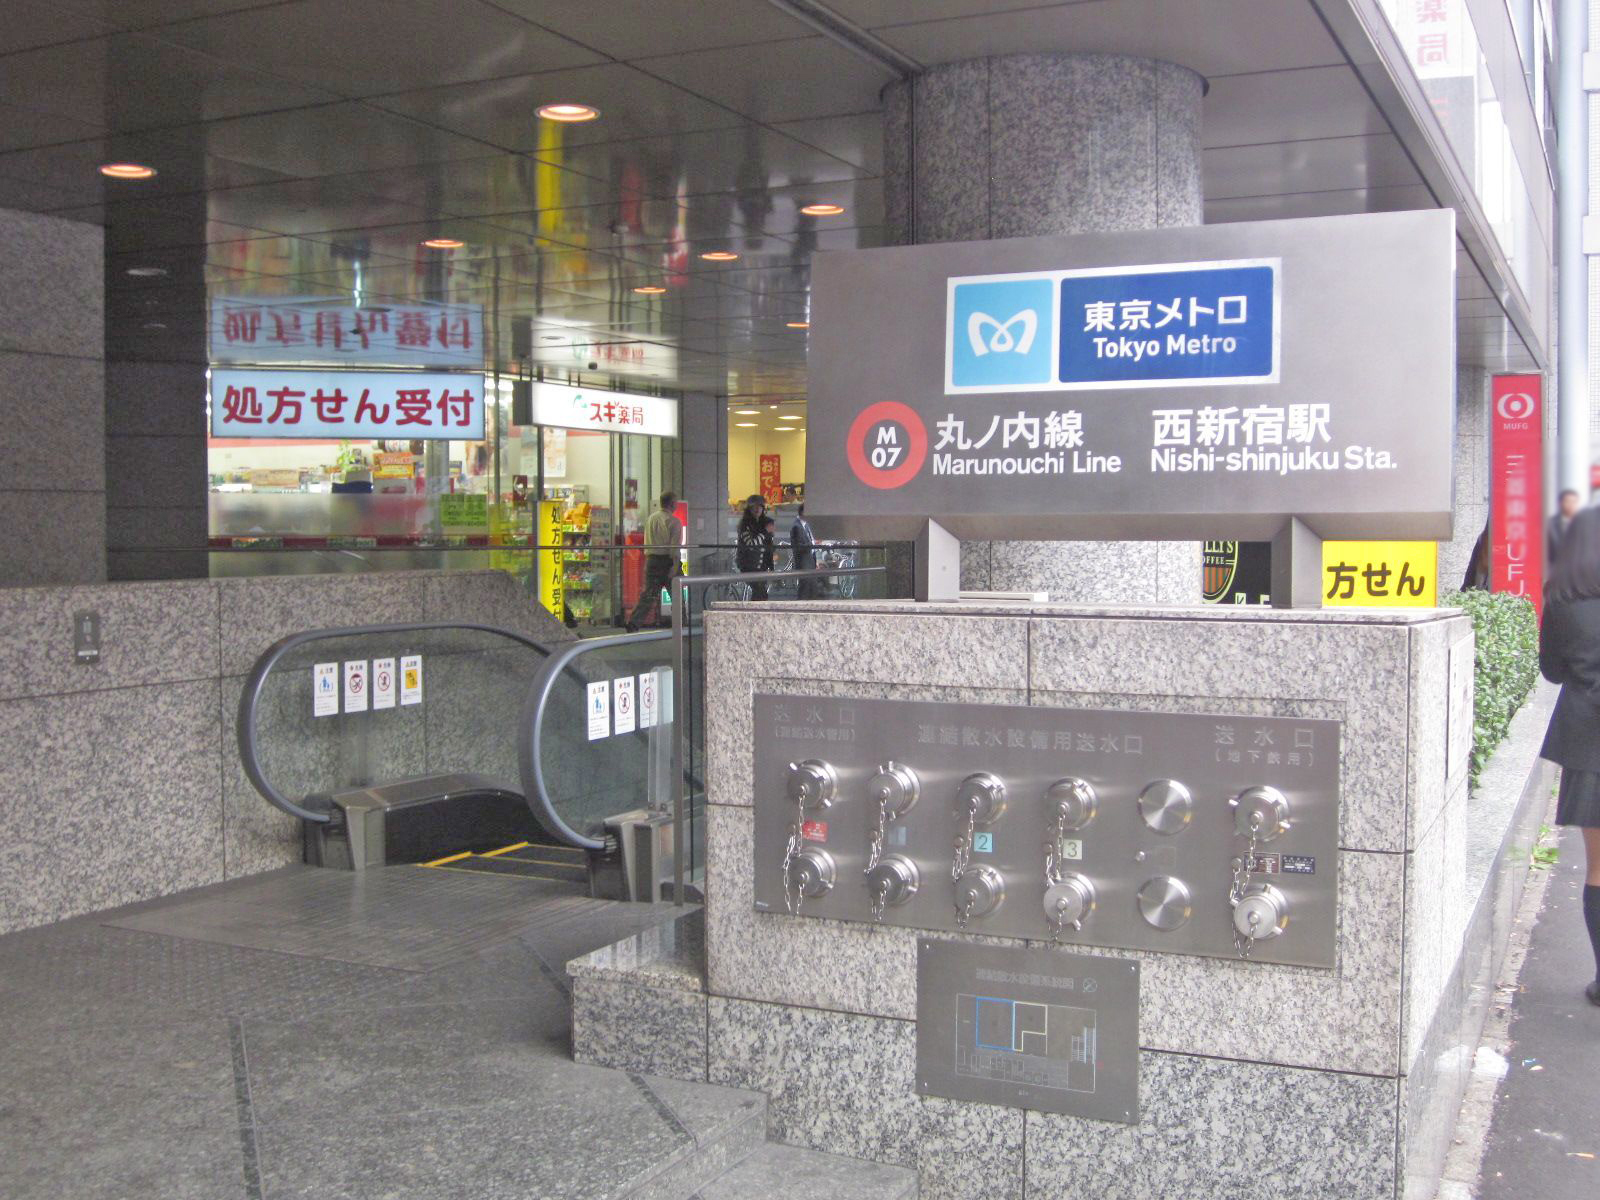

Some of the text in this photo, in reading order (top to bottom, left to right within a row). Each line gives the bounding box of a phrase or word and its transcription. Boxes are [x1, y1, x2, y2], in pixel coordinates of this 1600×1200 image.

[1083, 295, 1248, 332] 東京メトロ
[1092, 333, 1237, 363] Tokyo Metro
[222, 384, 475, 427] 処方せん受付
[589, 400, 644, 426] スギ薬局
[876, 426, 897, 445] M
[933, 403, 1332, 452] 丸ノ内線 西新宿駅
[1503, 422, 1529, 431] MUFG
[871, 448, 902, 469] 07
[932, 447, 1398, 477] Marunouchi Line Nishi-shinjuku Sta.
[1505, 454, 1526, 598] 三UFJ
[1326, 561, 1426, 600] 方せん
[977, 834, 988, 851] 2
[1066, 841, 1078, 858] 3
